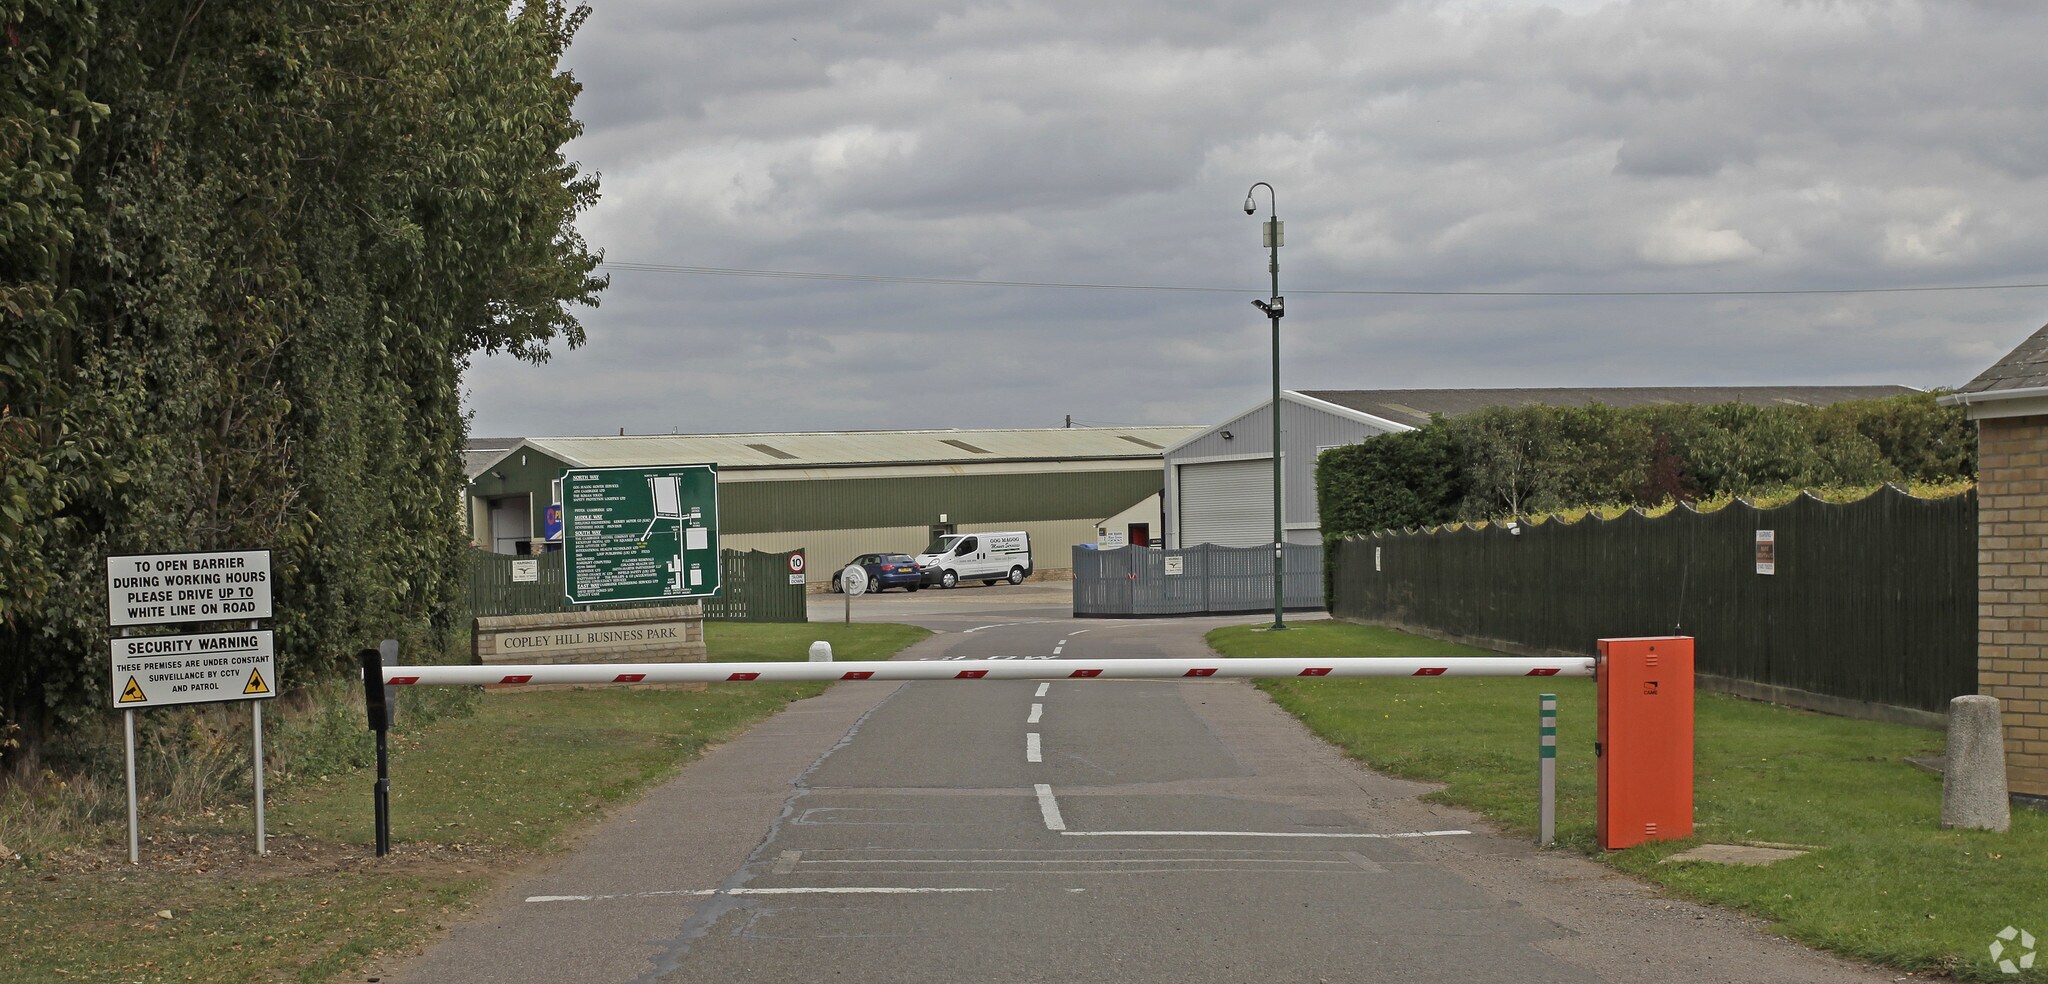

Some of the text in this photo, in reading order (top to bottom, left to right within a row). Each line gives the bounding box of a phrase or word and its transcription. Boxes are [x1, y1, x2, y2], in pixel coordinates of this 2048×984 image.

[135, 558, 244, 572] TO OPEN BARRIER
[792, 558, 801, 567] 10
[114, 572, 265, 588] DURING WORKING HOURS
[128, 587, 253, 603] PLEASE DRIVE UP TO
[128, 602, 255, 618] WHITE LINE ON ROAD
[128, 636, 258, 654] SECURITY WARNING
[504, 628, 678, 649] COPLEY HILL BUSINESS PARK
[117, 663, 141, 672] THESE
[145, 661, 182, 670] PREMISES
[203, 658, 228, 666] UNDER
[231, 656, 269, 664] CONSTANT
[149, 672, 204, 682] SURVEILLANCE
[191, 683, 219, 691] PATROL
